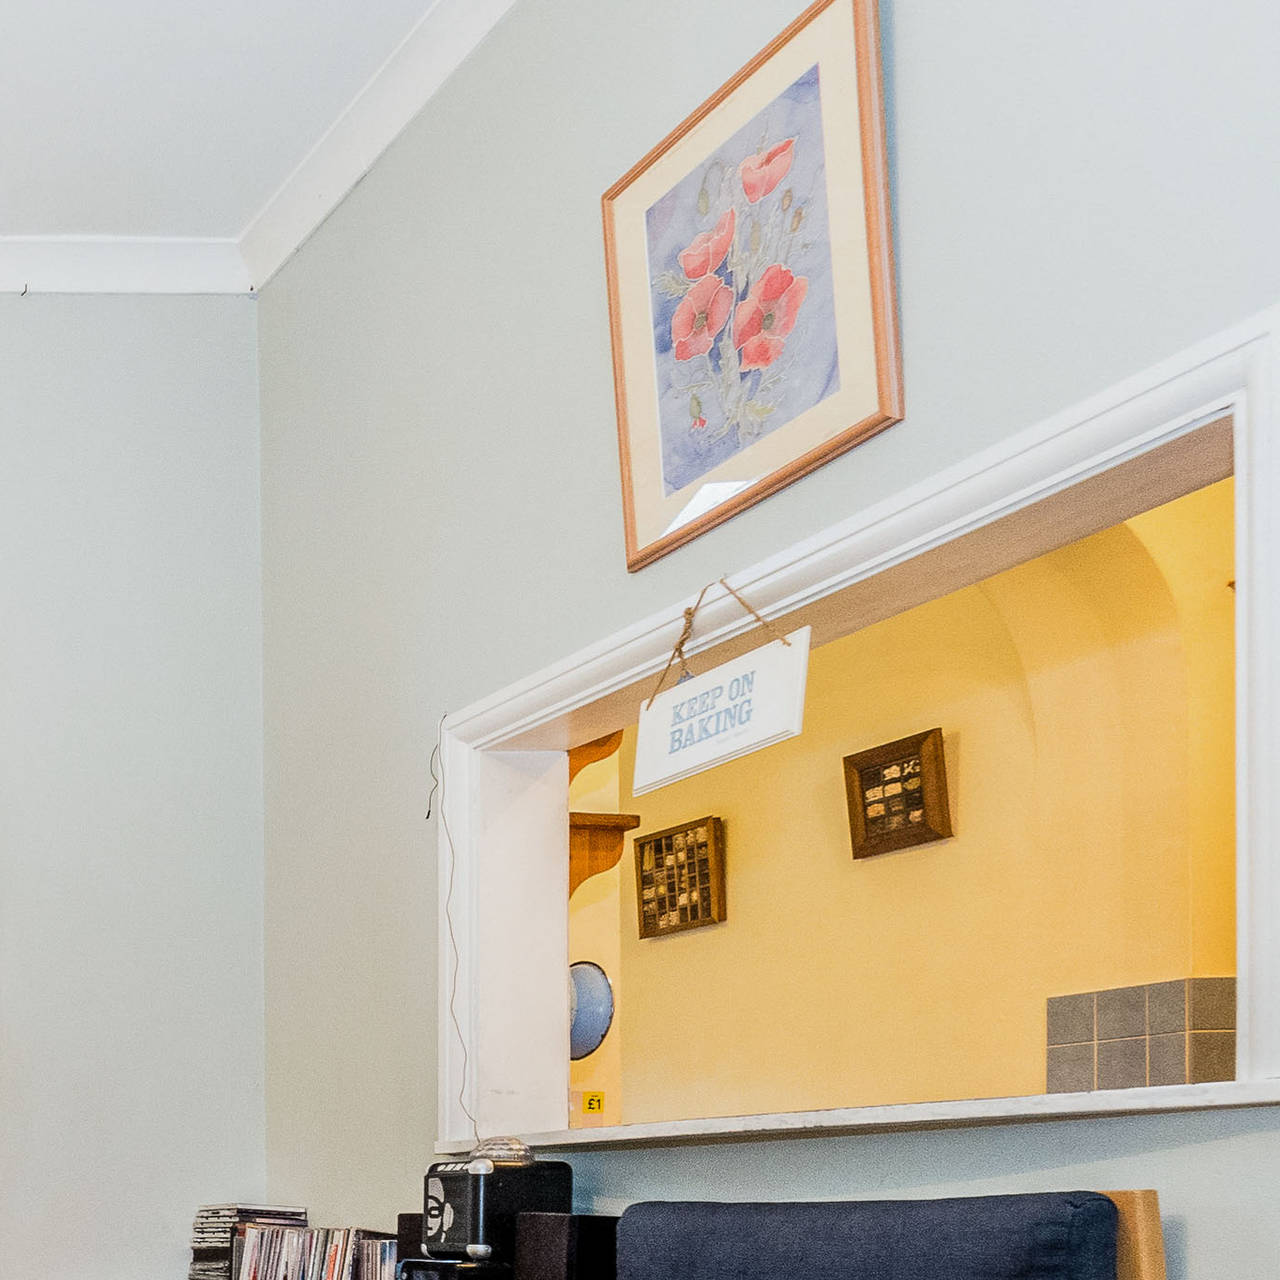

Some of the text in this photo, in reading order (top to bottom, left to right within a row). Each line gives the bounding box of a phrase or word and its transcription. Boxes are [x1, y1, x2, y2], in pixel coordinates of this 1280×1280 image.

[671, 670, 756, 727] KEEP ON
[669, 699, 752, 754] BAKING
[588, 1098, 600, 1110] £1
